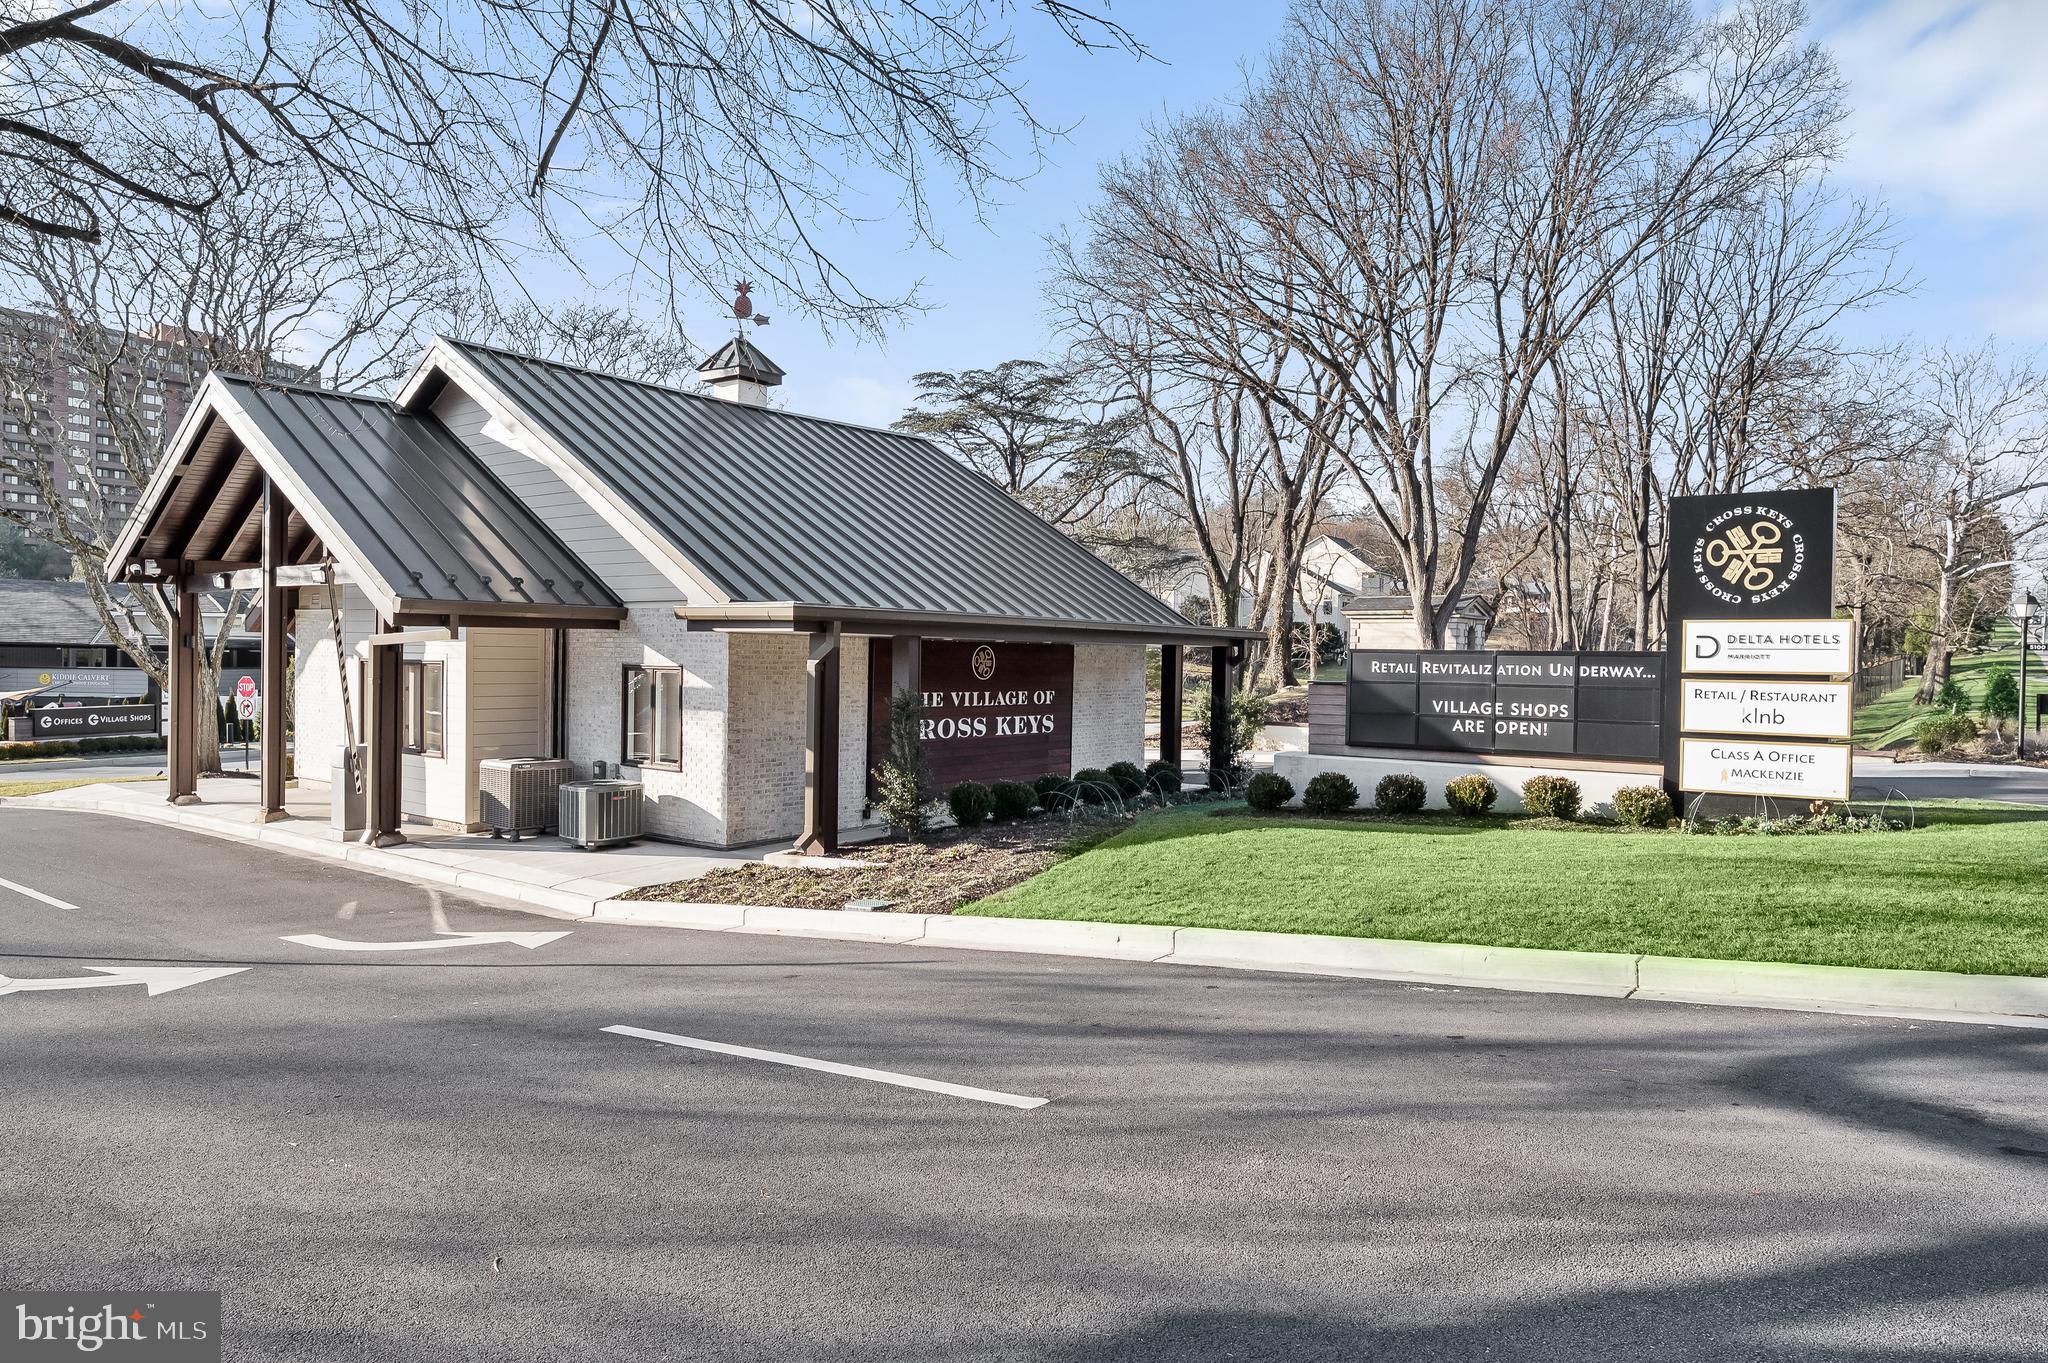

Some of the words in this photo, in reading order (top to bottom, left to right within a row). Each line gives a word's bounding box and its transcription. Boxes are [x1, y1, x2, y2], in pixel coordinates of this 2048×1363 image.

[1706, 506, 1752, 532] CROSS
[1755, 506, 1794, 529] KEYS
[1693, 538, 1705, 574] KEYS
[1788, 534, 1804, 581] CROSS
[1699, 575, 1742, 604] CROSS
[1751, 580, 1792, 604] KEYS
[1727, 634, 1774, 645] DELTA
[1780, 634, 1840, 645] HOTELS
[1371, 661, 1417, 675] RETAIL
[240, 683, 254, 691] STOP
[1694, 688, 1737, 701] RETAIL
[1750, 690, 1838, 703] RESTAURANT
[951, 690, 1028, 708] VILLAGE
[1034, 690, 1056, 704] OF
[1432, 700, 1504, 716] VILLAGE
[1510, 702, 1569, 718] SHOPS
[53, 718, 83, 726] OFFICES
[100, 715, 128, 723] VILLAGE
[130, 714, 152, 722] SHOPS
[920, 717, 987, 740] ROSS
[995, 714, 1054, 736] KEYS
[1452, 720, 1485, 734] ARE
[1494, 721, 1548, 736] OPEN!
[1710, 748, 1750, 761] CLASS
[1753, 750, 1764, 762] A
[1768, 751, 1816, 764] OFFICE
[1731, 768, 1804, 781] MACKENZIE
